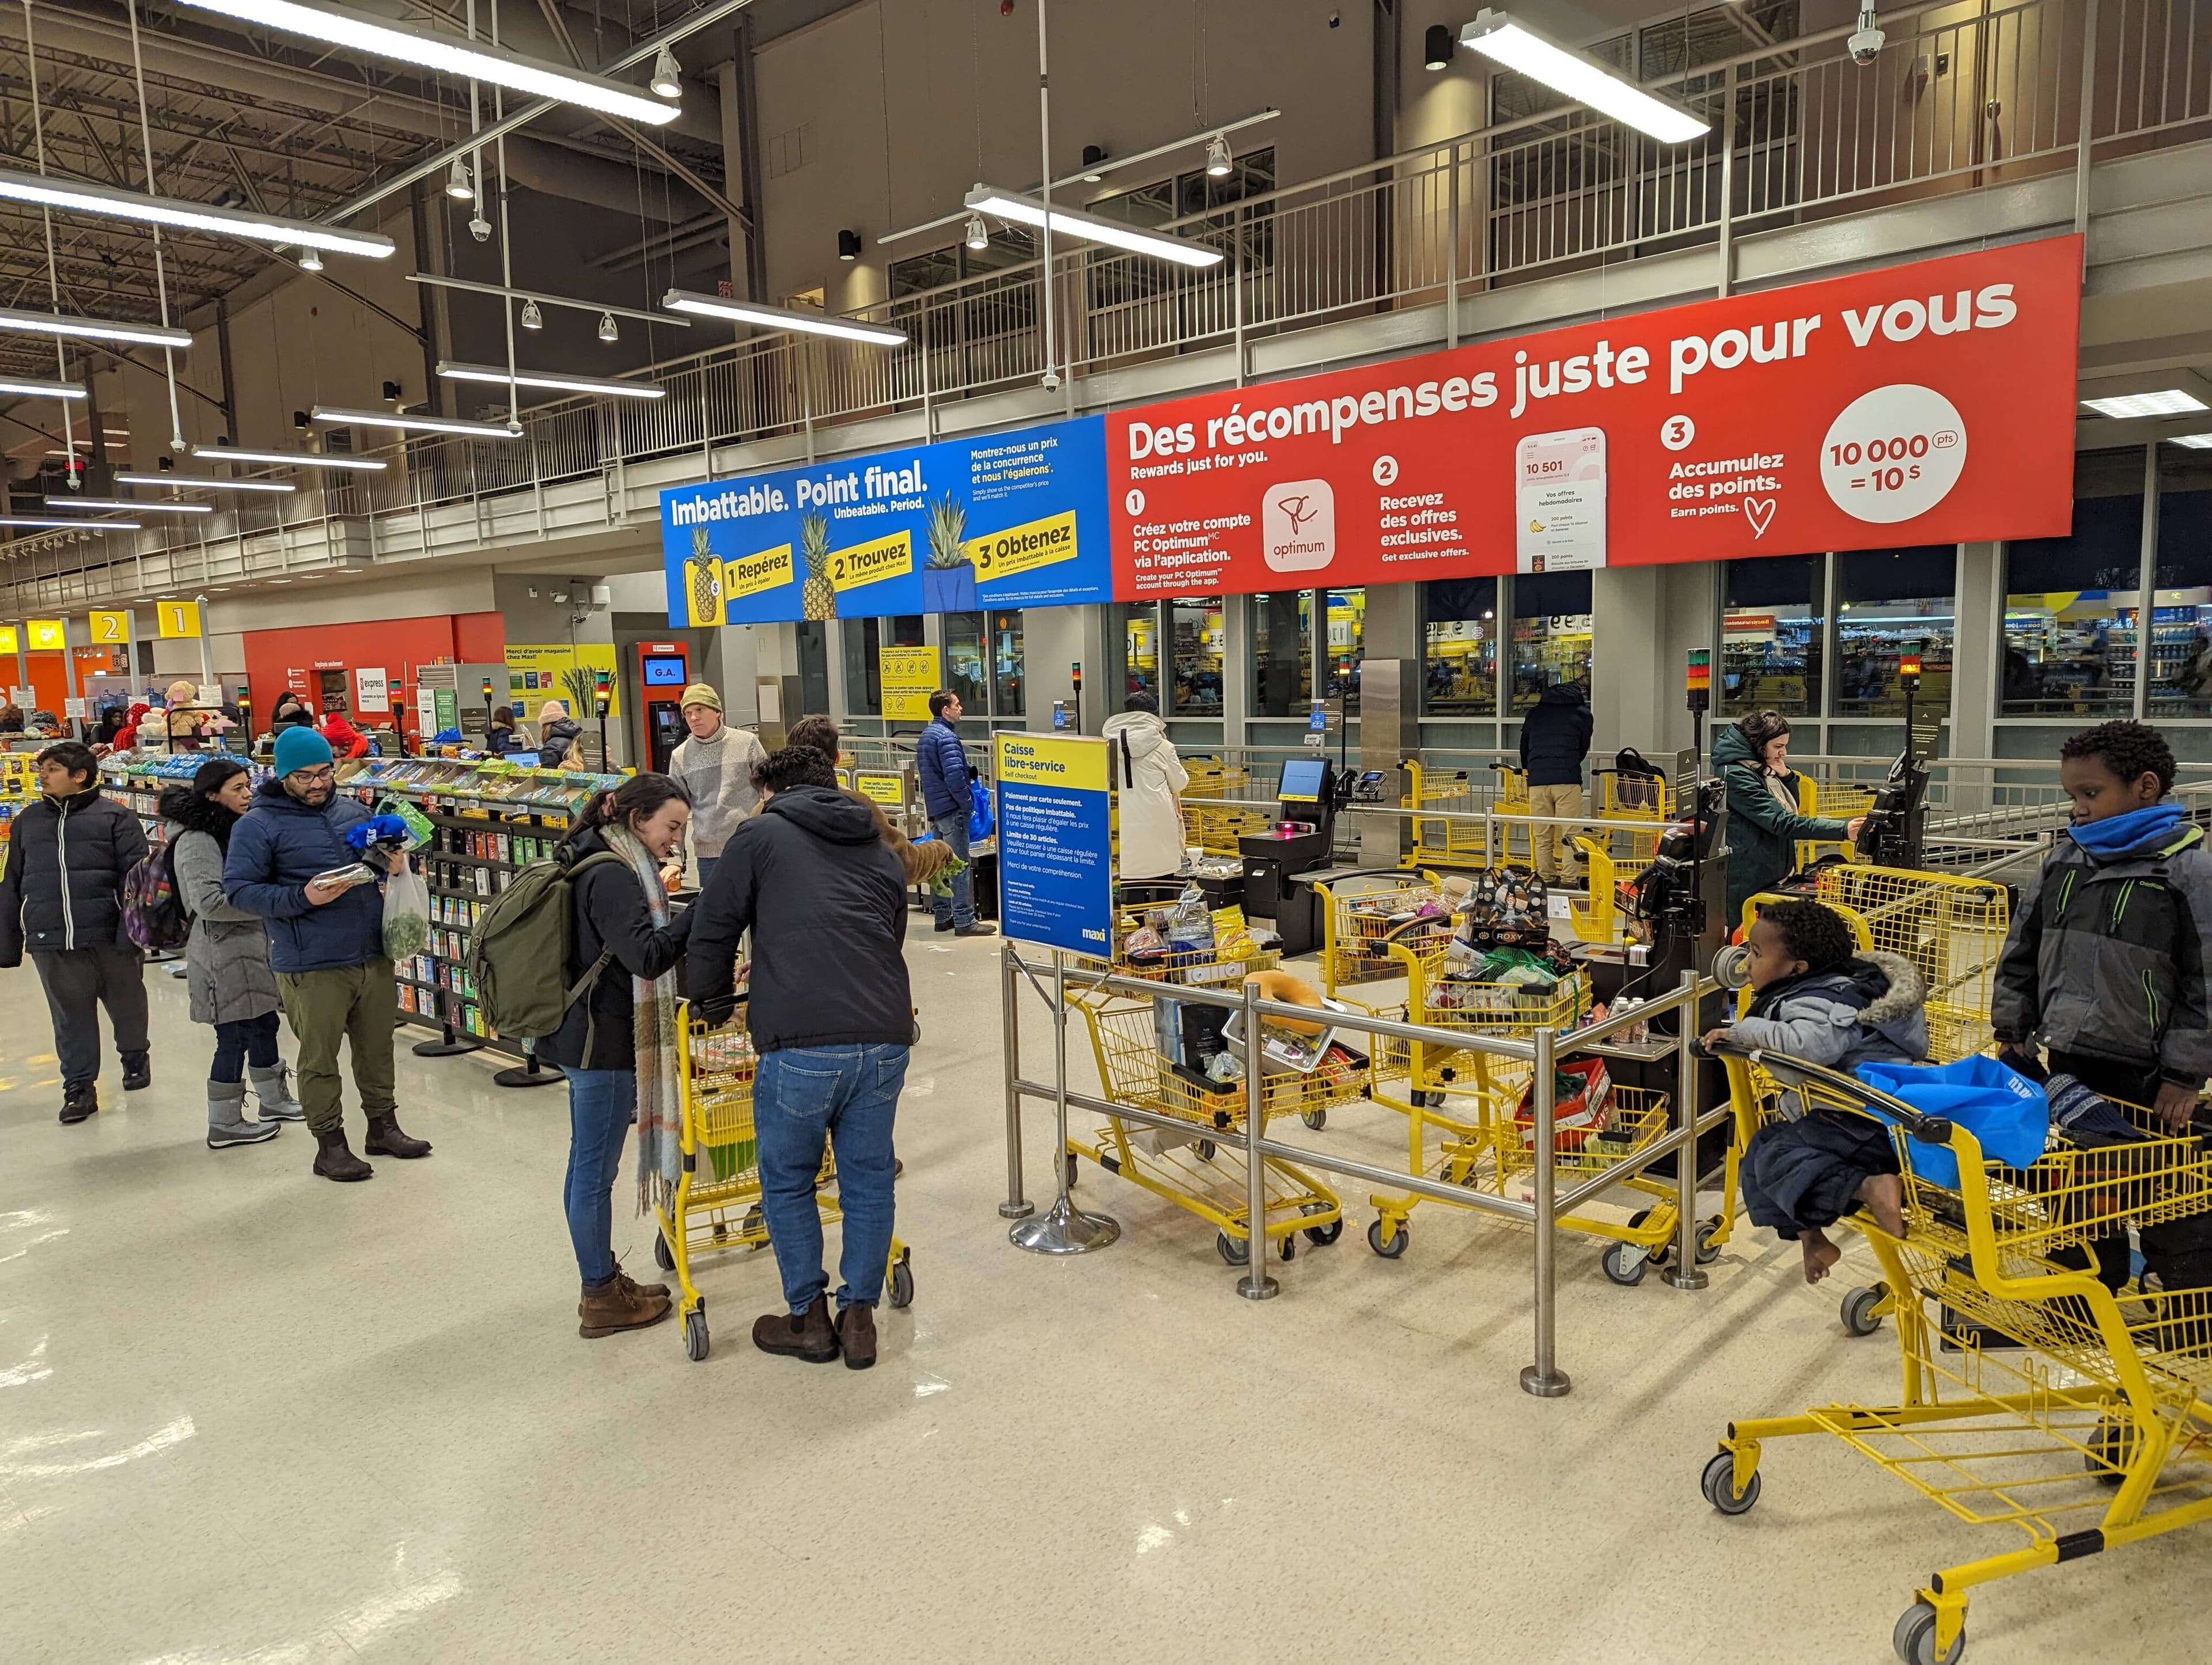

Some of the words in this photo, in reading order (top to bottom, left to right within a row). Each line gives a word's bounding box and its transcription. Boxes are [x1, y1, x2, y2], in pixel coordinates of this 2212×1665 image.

[1129, 421, 1195, 460] Des
[1207, 370, 1499, 448] récompenses
[1510, 342, 1649, 419] juste
[1669, 313, 1821, 394] pour
[1840, 283, 2017, 348] vous
[1670, 422, 1685, 443] 3
[971, 443, 1026, 460] Montrez-nous
[1028, 441, 1038, 450] un
[1041, 437, 1058, 450] prix
[1830, 442, 1862, 466] 10
[1868, 435, 1929, 462] 000
[1938, 434, 1953, 446] pts
[972, 462, 981, 472] de
[983, 460, 991, 471] la
[993, 453, 1043, 468] concurrence
[1130, 460, 1184, 479] Rewards
[1187, 456, 1211, 475] just
[1214, 454, 1235, 468] for
[1238, 450, 1268, 468] you.
[1380, 461, 1391, 479] 2
[1527, 464, 1539, 474] 10
[1542, 461, 1562, 472] 501
[1669, 453, 1784, 479] Accumulez
[972, 475, 980, 484] et
[983, 473, 1001, 482] nous
[1012, 482, 1037, 490] competitor's
[1038, 480, 1049, 488] price
[1669, 483, 1704, 500] des
[1710, 475, 1782, 499] points.
[671, 484, 789, 526] Imbattable.
[796, 470, 859, 509] Point
[865, 460, 927, 499] final.
[1380, 492, 1444, 510] Recevez
[1539, 498, 1582, 506] hebdomadaires
[834, 503, 888, 519] Unbeatable.
[891, 496, 925, 512] Period.
[1131, 495, 1138, 510] 1
[1671, 508, 1696, 518] Earn
[1699, 503, 1739, 517] points.
[1133, 522, 1166, 537] Créez
[1169, 519, 1200, 533] votre
[1203, 514, 1251, 529] compte
[1380, 514, 1407, 528] des
[1411, 509, 1457, 526] offres
[1134, 539, 1149, 552] PC
[1380, 528, 1463, 546] exclusives.
[979, 544, 991, 569] 3
[997, 525, 1070, 558] Obtenez
[1006, 558, 1016, 567] prix
[1017, 551, 1043, 563] imbattable
[1055, 545, 1070, 553] caisse
[1274, 540, 1325, 559] optimum
[1382, 553, 1397, 562] Get
[1399, 550, 1438, 560] exclusive
[1440, 548, 1469, 557] offers.
[835, 559, 845, 580] 2
[849, 543, 906, 571] Trouvez
[1134, 555, 1152, 568] via
[1154, 549, 1231, 568] l'application.
[729, 568, 734, 588] 1
[738, 554, 788, 580] Repérez
[855, 570, 868, 578] même
[869, 566, 884, 575] produit
[1135, 573, 1157, 582] Create
[1158, 573, 1173, 582] your
[1136, 581, 1162, 590] account
[1163, 578, 1190, 588] through
[1204, 577, 1219, 586] app.
[101, 616, 119, 639] 2
[173, 607, 185, 633] 1
[39, 624, 53, 646] 3
[655, 668, 676, 677] G.A.
[364, 680, 384, 690] express
[1004, 742, 1035, 756] Caisse
[1004, 756, 1065, 773] libre-service
[1005, 792, 1028, 801] Paiement
[1039, 795, 1052, 803] carte
[1052, 796, 1082, 806] seulement.
[1022, 806, 1045, 815] politique
[1046, 808, 1076, 818] imbattable.
[1036, 824, 1058, 832] régulière.
[1048, 817, 1069, 826] d'égaler
[1006, 830, 1021, 839] Limite
[1037, 835, 1058, 844] articles.
[1006, 839, 1025, 847] Veuillez
[1074, 849, 1098, 858] régulière
[1047, 852, 1073, 862] dépassant
[1080, 857, 1096, 866] limite.
[1043, 867, 1083, 879] compréhension.
[1082, 928, 1106, 942] maxi
